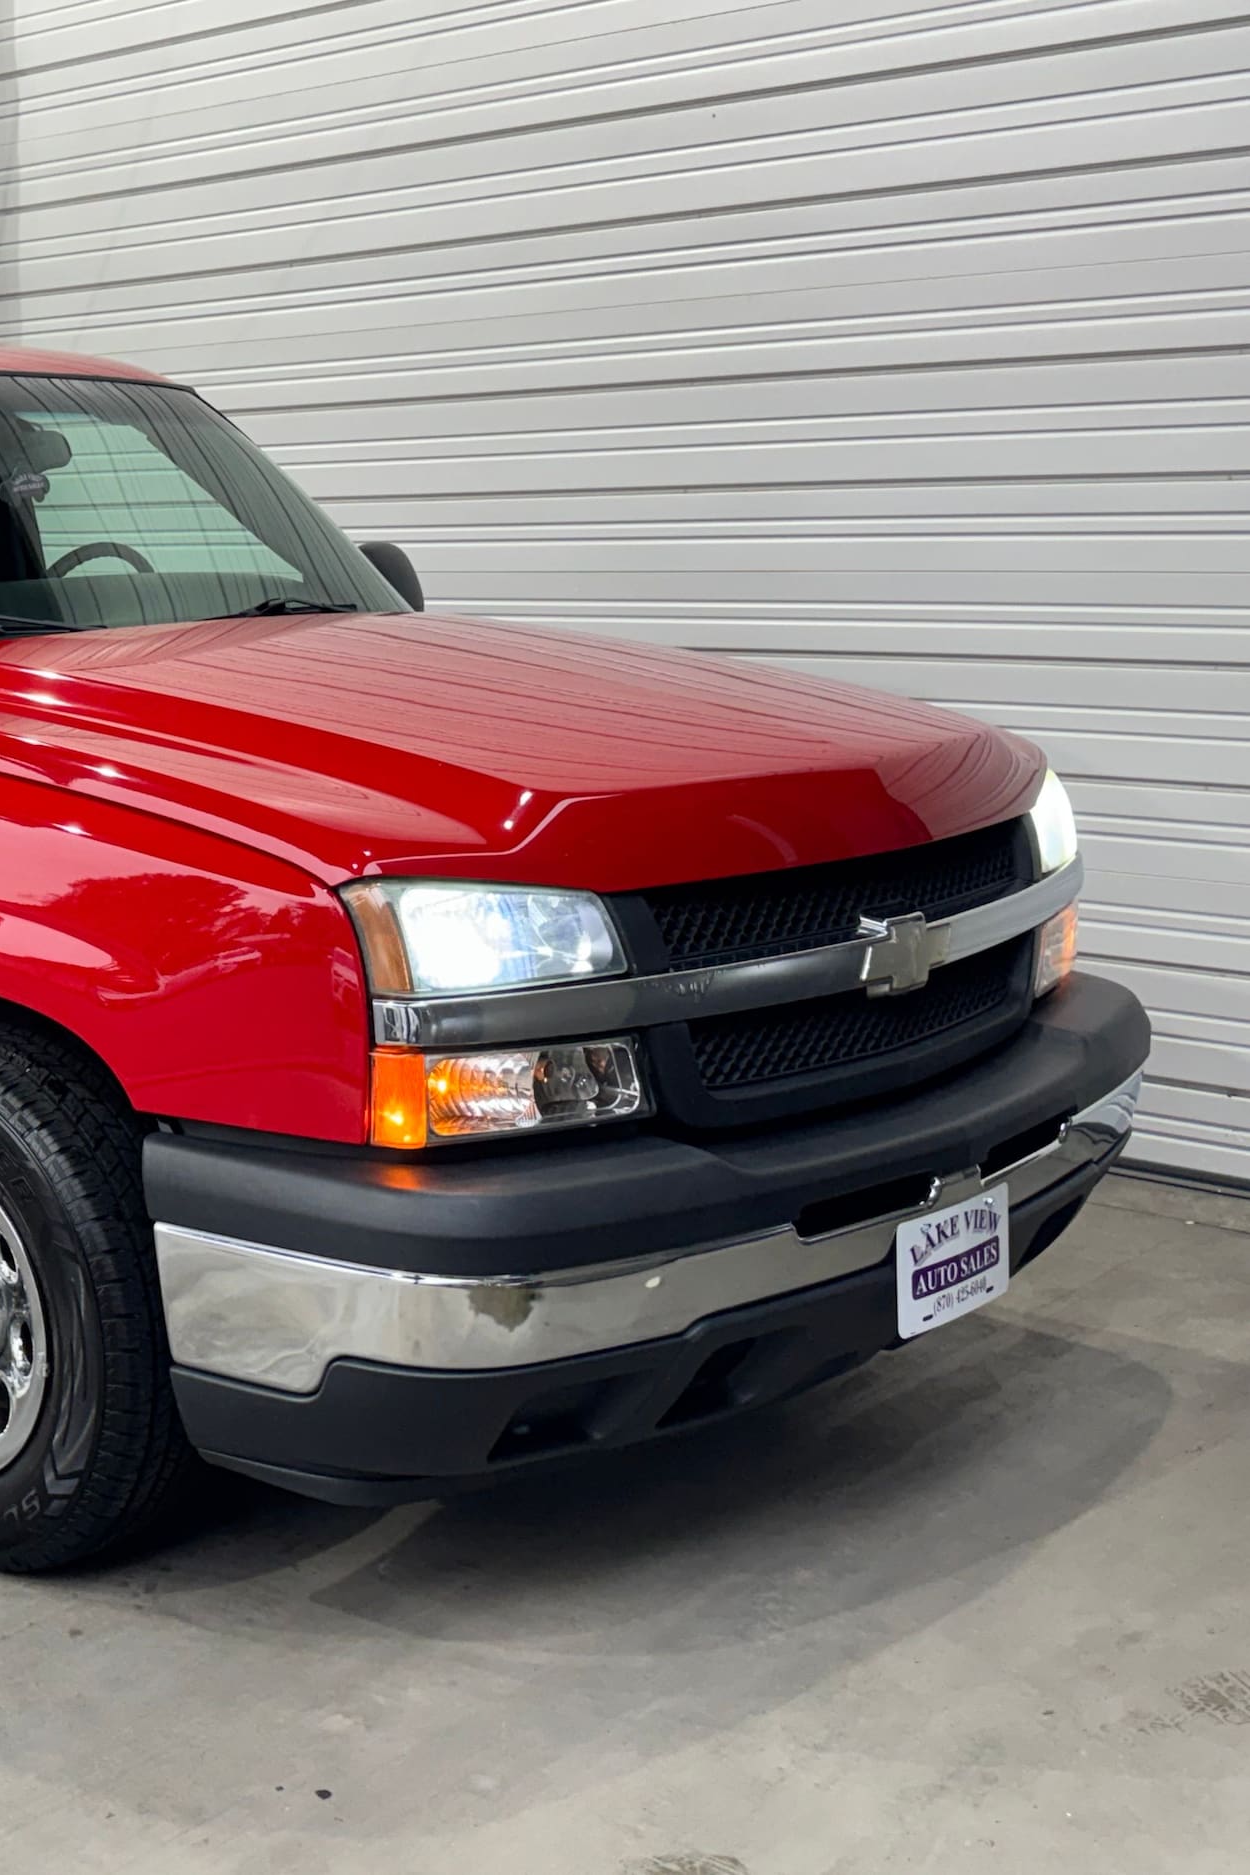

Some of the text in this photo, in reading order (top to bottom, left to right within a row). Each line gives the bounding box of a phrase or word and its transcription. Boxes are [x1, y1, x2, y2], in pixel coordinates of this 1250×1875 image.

[910, 1209, 1002, 1266] LAKE VIEW
[916, 1243, 998, 1295] AUTO SALES
